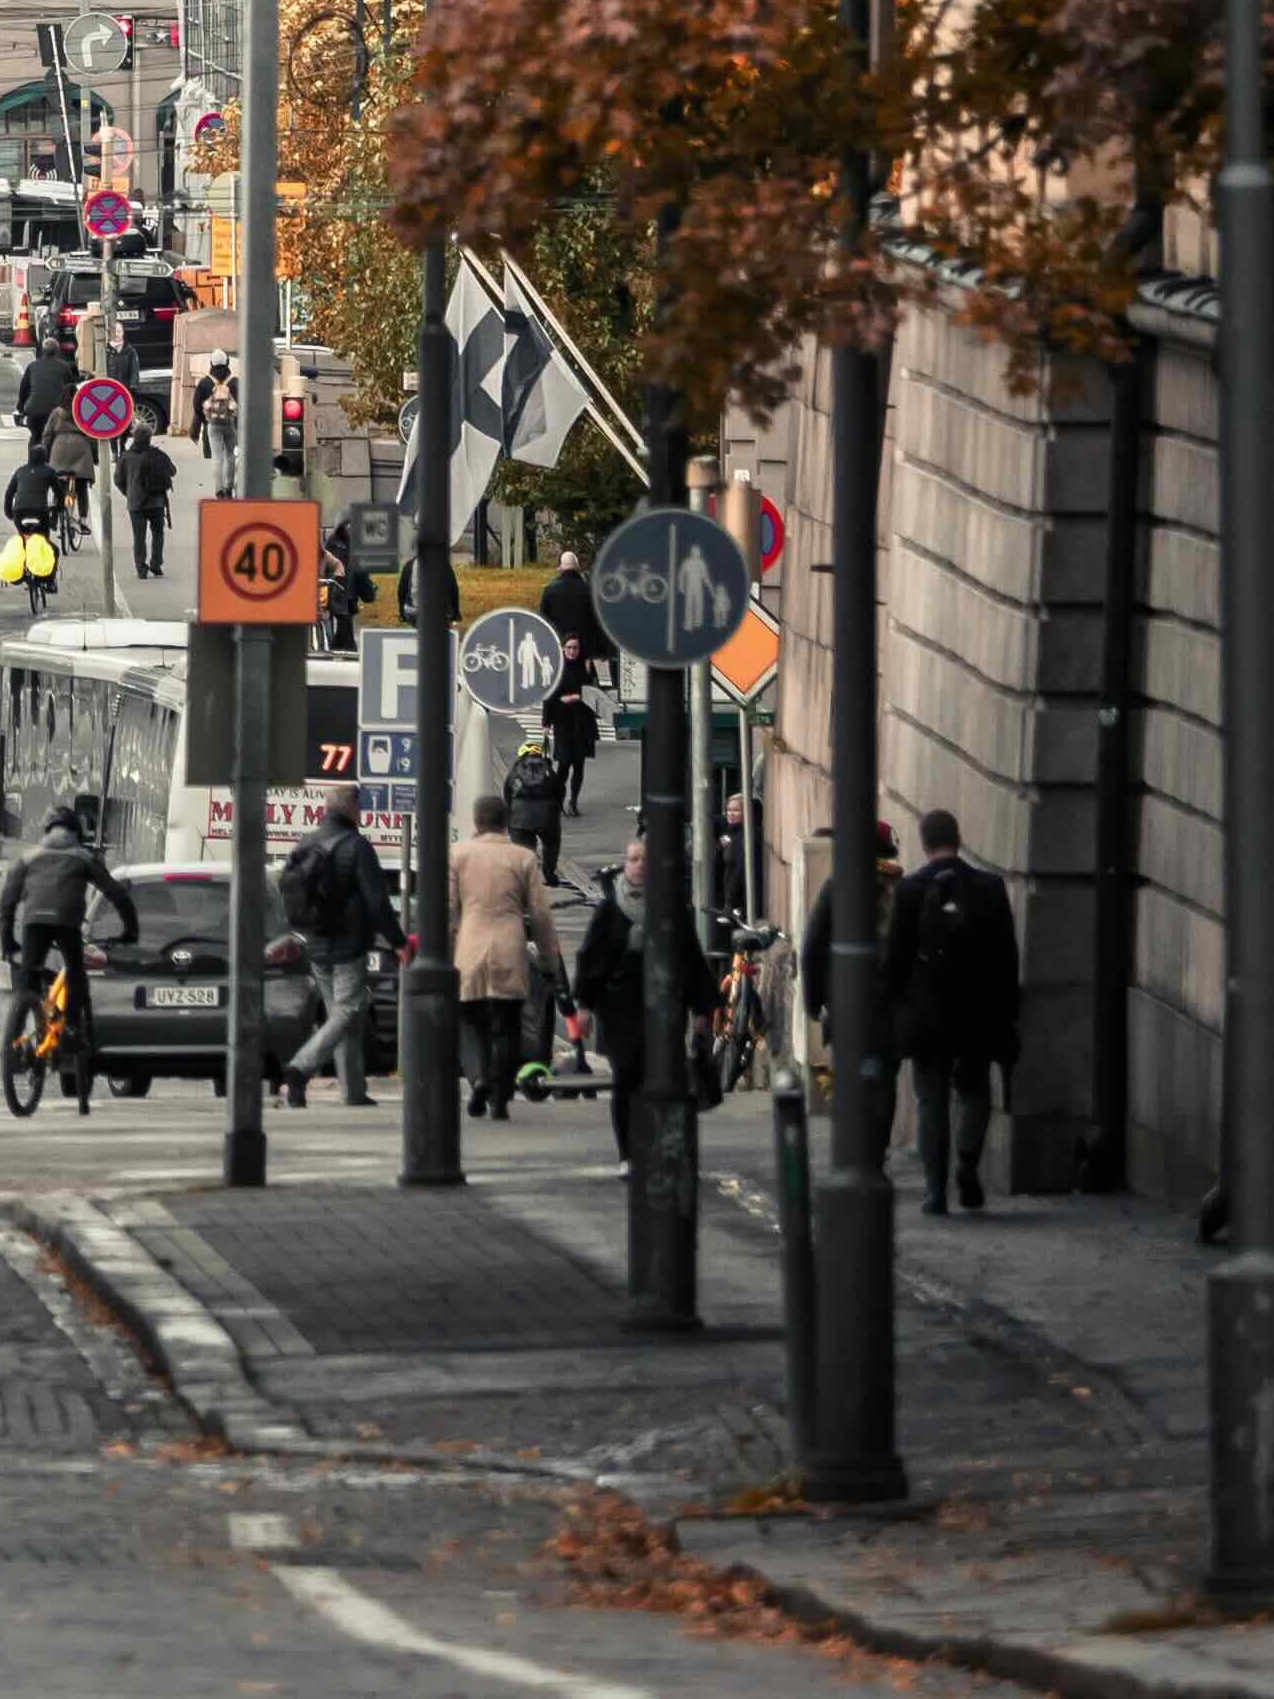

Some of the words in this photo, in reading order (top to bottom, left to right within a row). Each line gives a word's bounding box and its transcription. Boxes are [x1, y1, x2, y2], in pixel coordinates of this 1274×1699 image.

[363, 517, 389, 537] WC
[233, 541, 285, 583] 40
[320, 743, 352, 772] 77
[290, 787, 300, 799] IS
[156, 988, 215, 1004] UVZ-528
